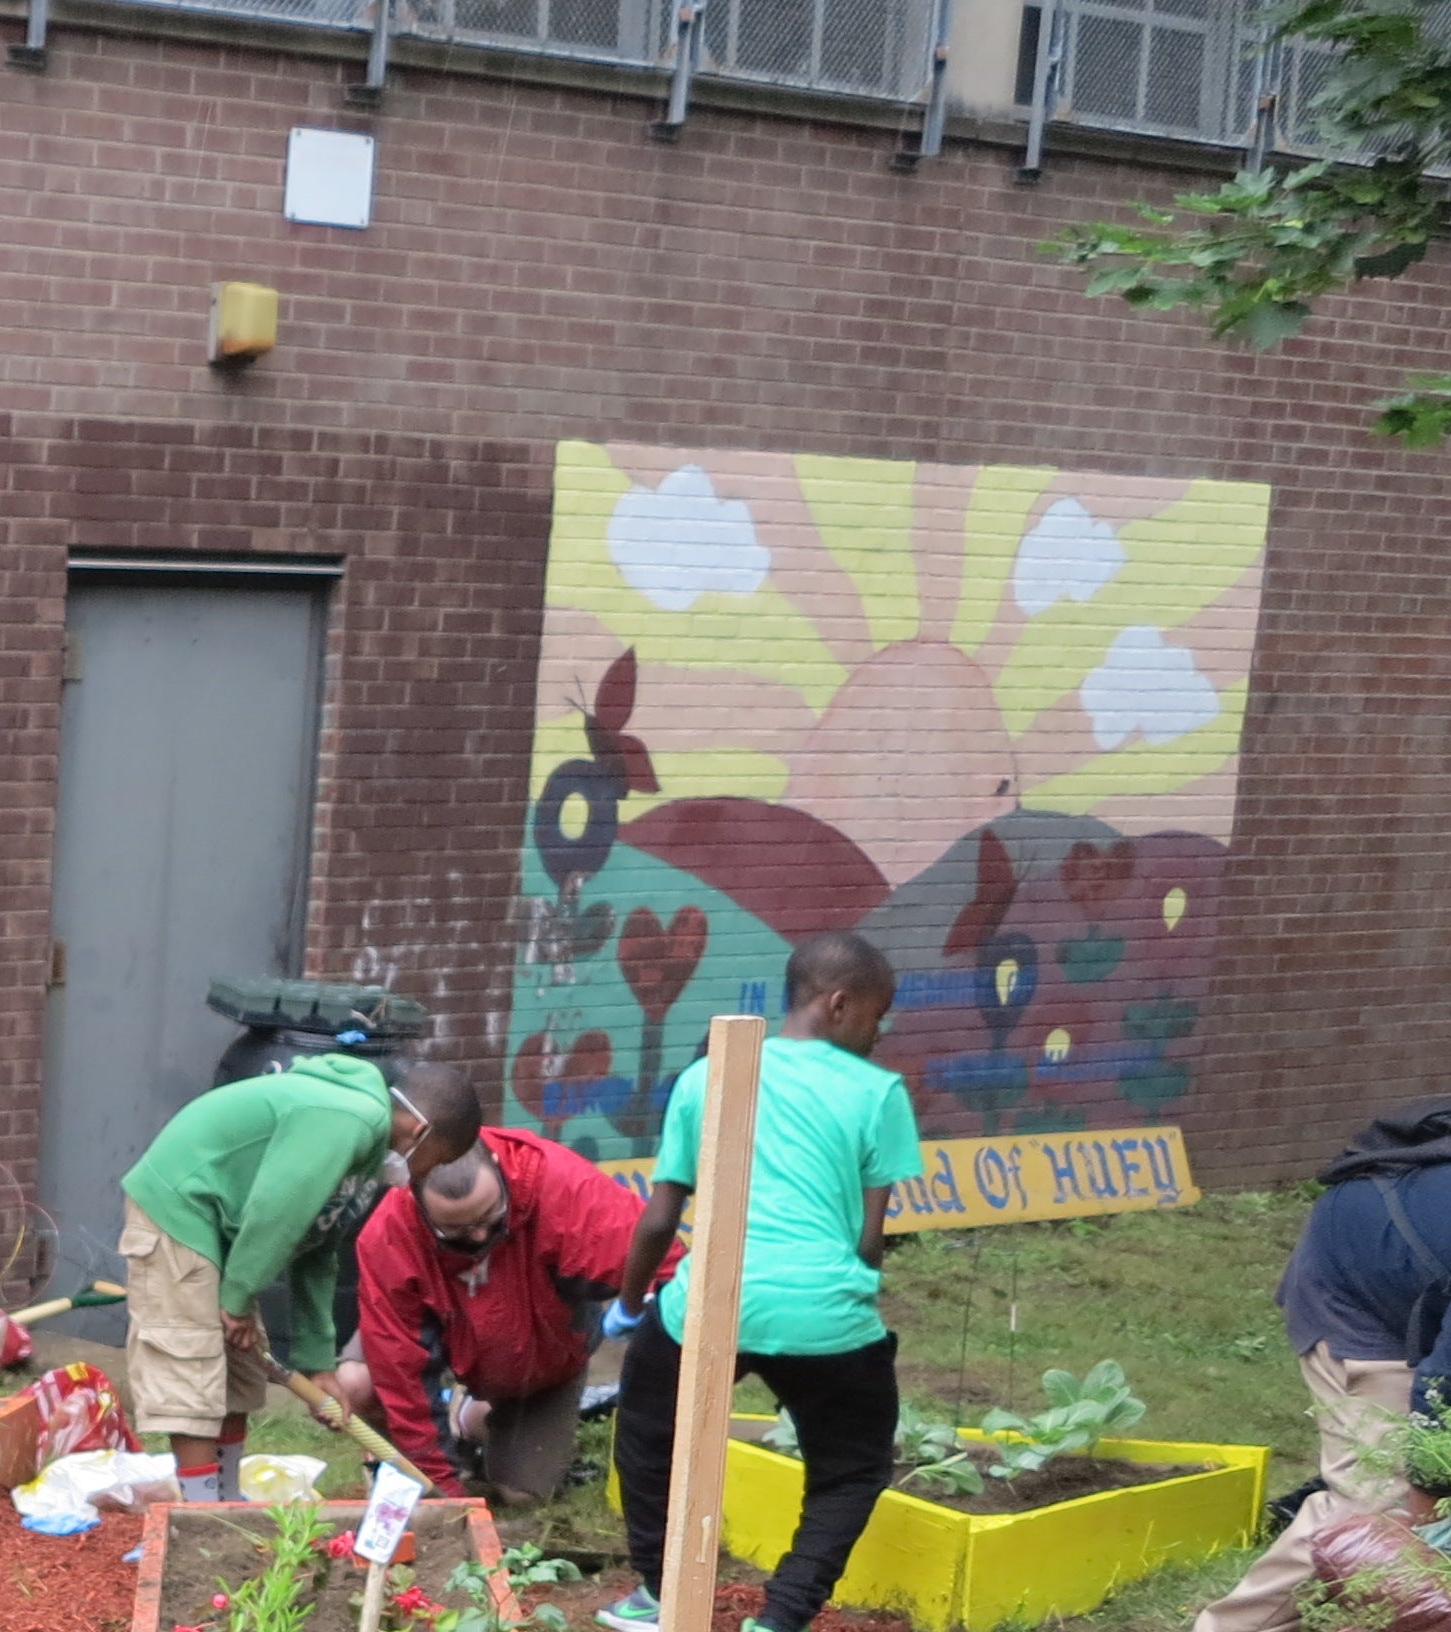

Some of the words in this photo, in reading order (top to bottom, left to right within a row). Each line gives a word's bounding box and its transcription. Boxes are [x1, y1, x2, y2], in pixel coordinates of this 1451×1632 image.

[740, 982, 766, 1013] IN
[885, 1148, 967, 1219] oud
[975, 1142, 1029, 1211] Of
